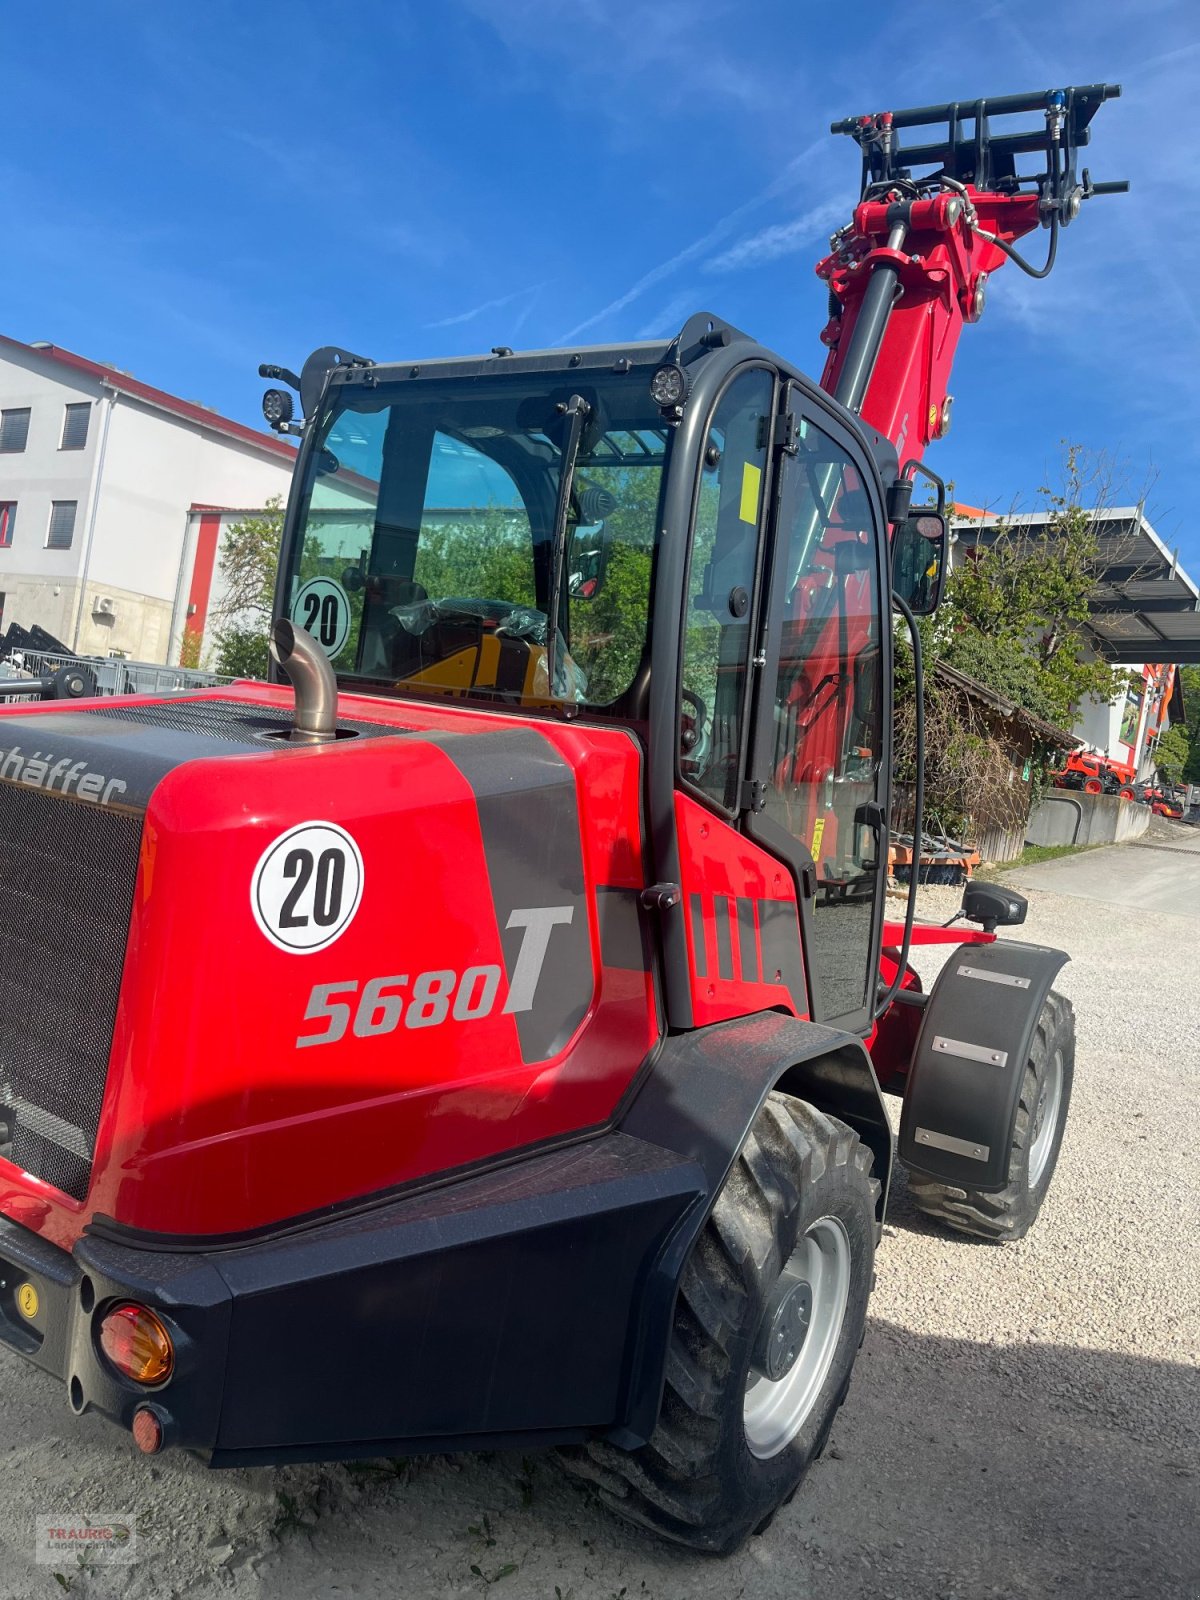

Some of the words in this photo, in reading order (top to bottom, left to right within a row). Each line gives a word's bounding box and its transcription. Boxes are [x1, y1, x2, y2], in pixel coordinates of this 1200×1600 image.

[304, 593, 338, 646] 20
[0, 746, 127, 805] häffer
[278, 848, 346, 928] 20
